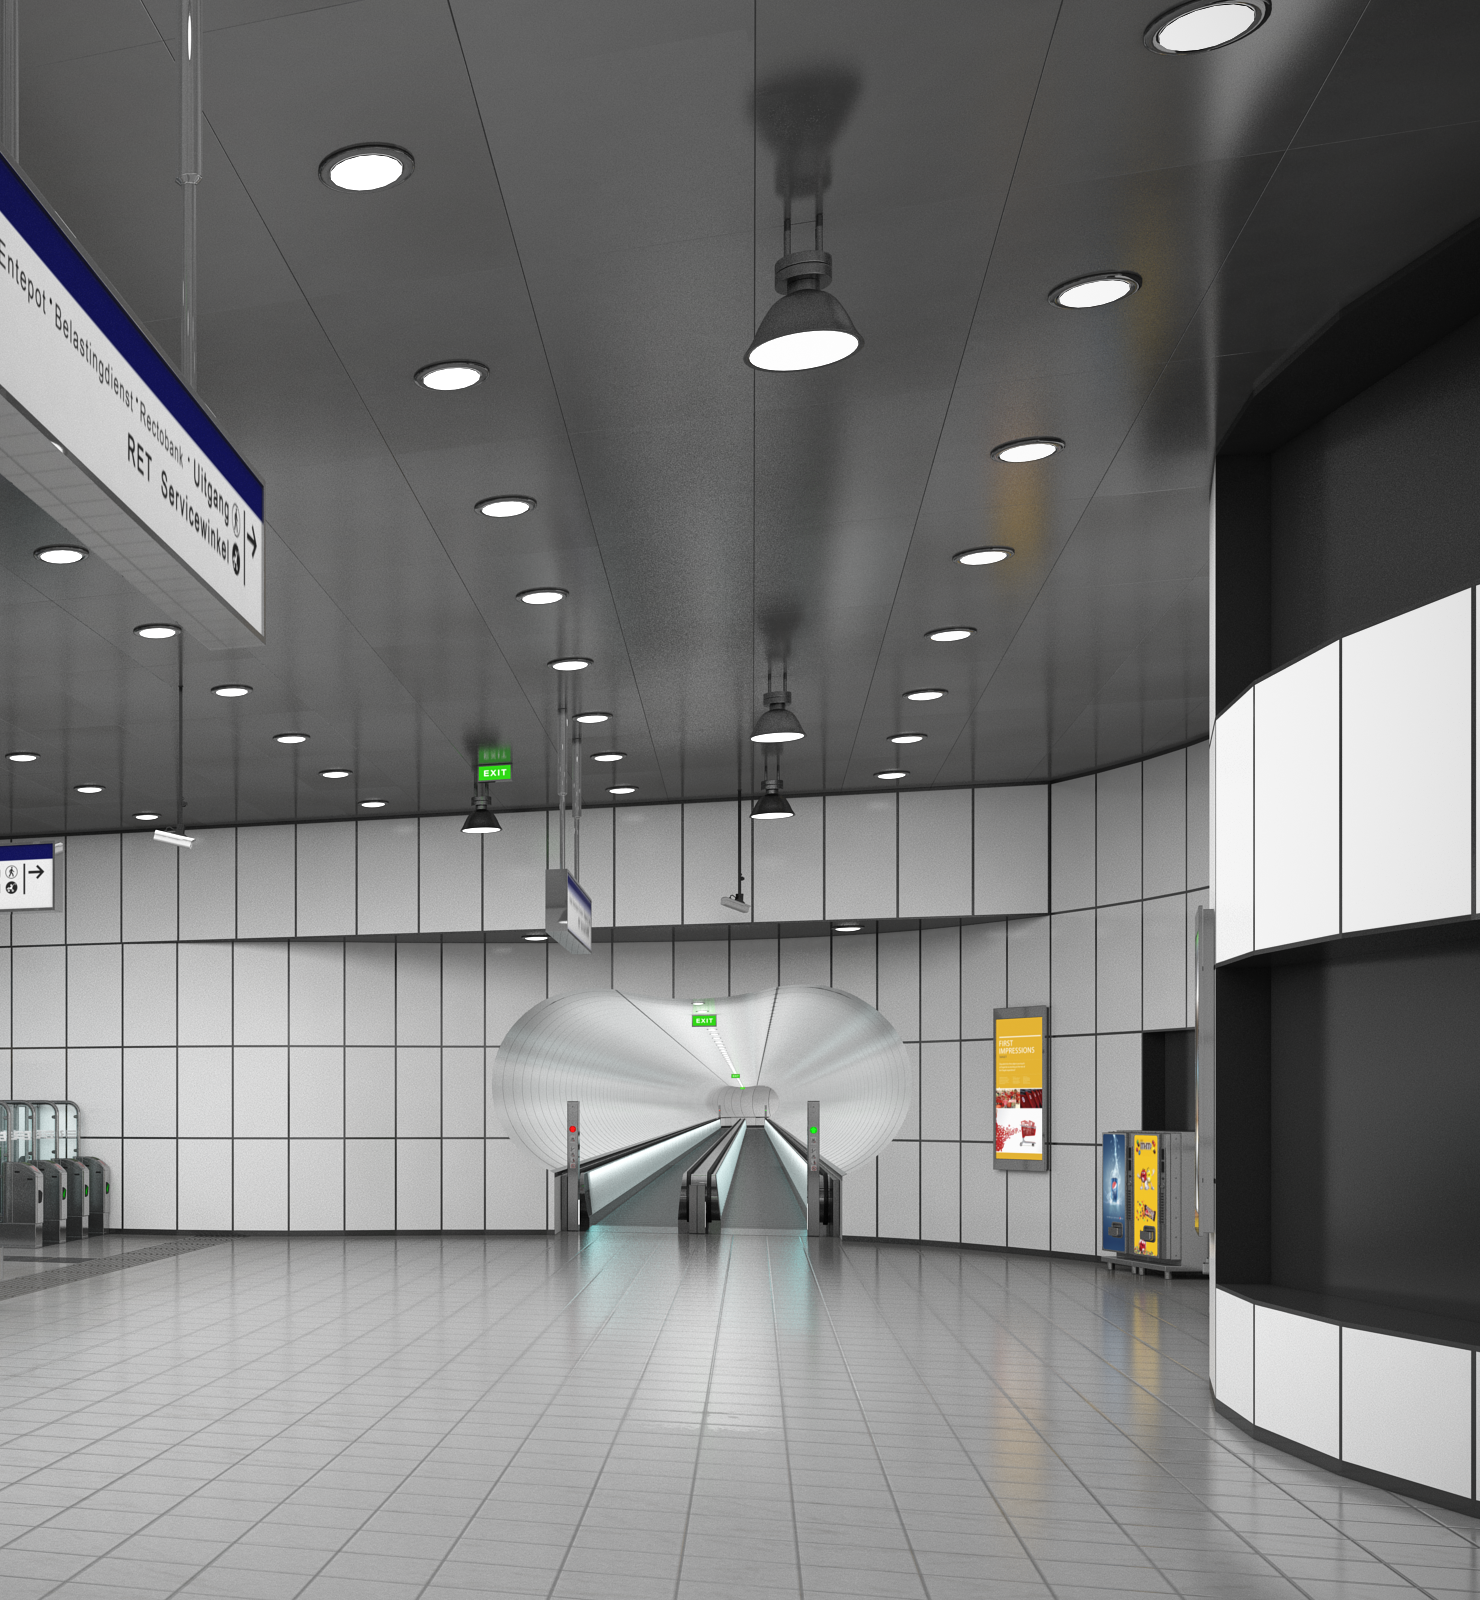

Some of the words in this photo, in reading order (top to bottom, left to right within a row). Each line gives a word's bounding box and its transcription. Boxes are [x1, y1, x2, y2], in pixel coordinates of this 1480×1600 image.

[54, 303, 135, 413] Belastingdienst
[140, 400, 184, 468] Rectobank
[193, 458, 231, 526] Uitgang
[127, 432, 154, 482] RET
[161, 470, 230, 563] Servicewinkel
[483, 768, 507, 777] EXIT
[999, 1047, 1035, 1055] IMPRESSIONS
